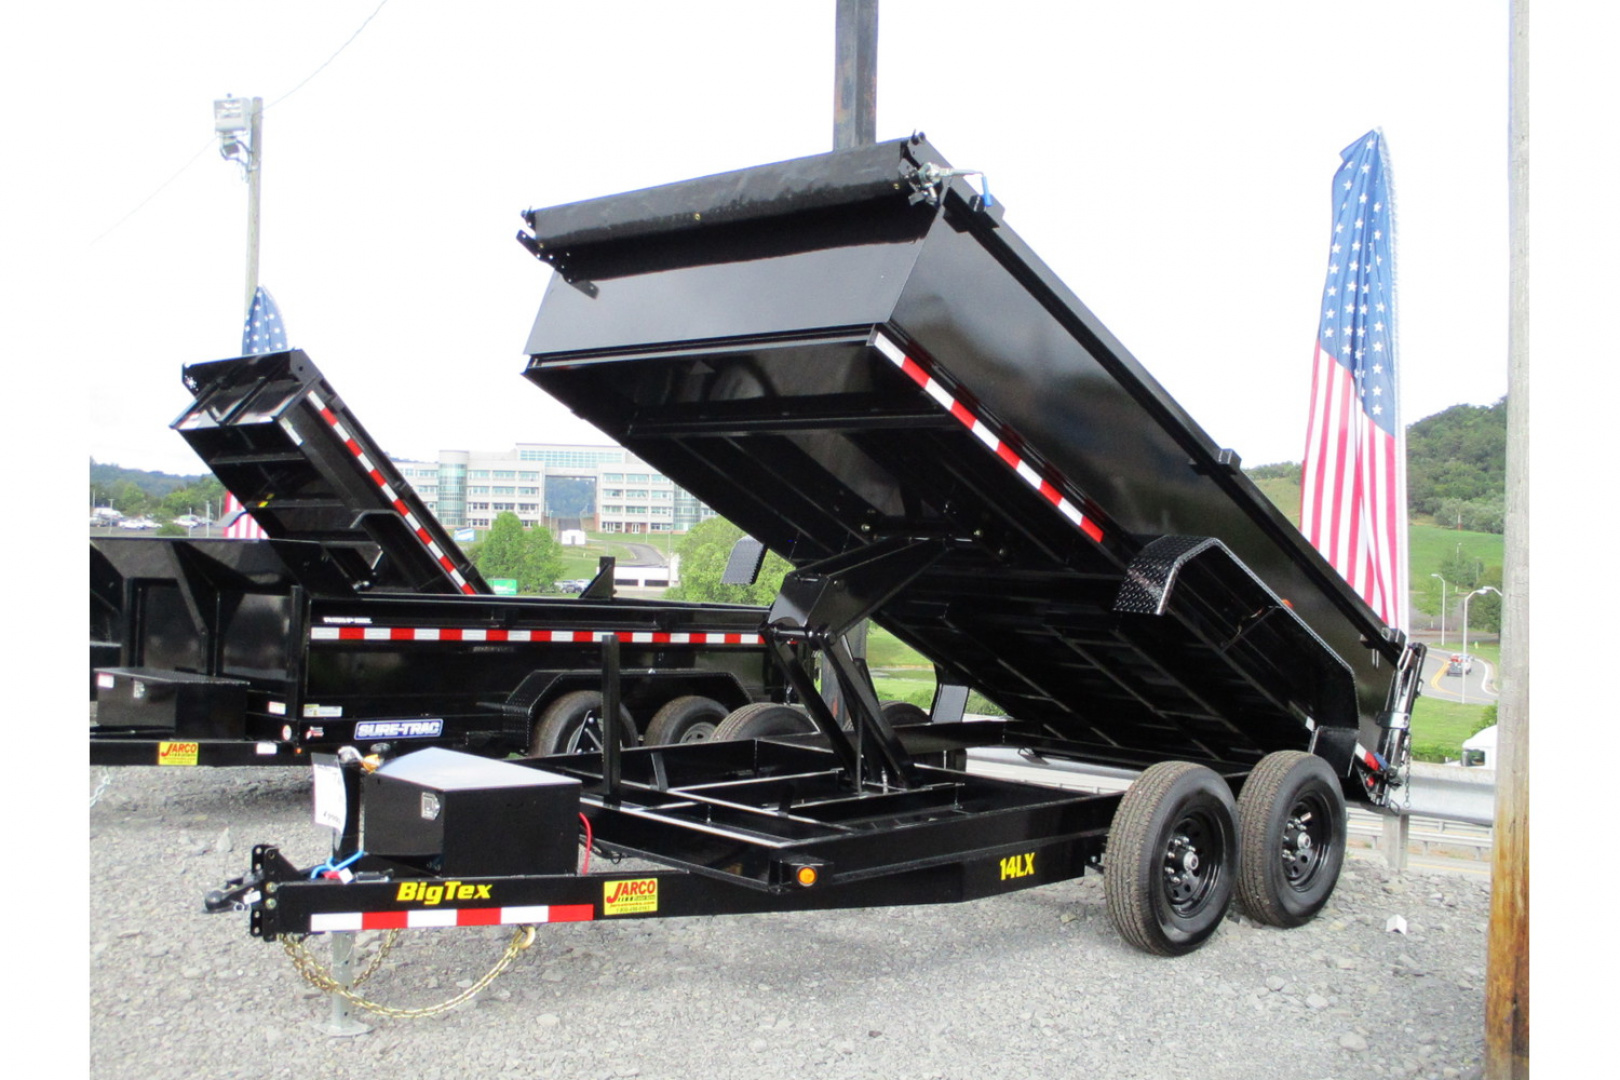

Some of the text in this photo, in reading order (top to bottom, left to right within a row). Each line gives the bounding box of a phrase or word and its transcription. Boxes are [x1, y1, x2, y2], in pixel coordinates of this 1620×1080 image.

[358, 722, 440, 737] SURE-TRAC
[160, 743, 197, 757] JARCO
[1000, 852, 1035, 880] 14LX
[396, 881, 493, 905] BigTex
[606, 880, 656, 904] JARCO
